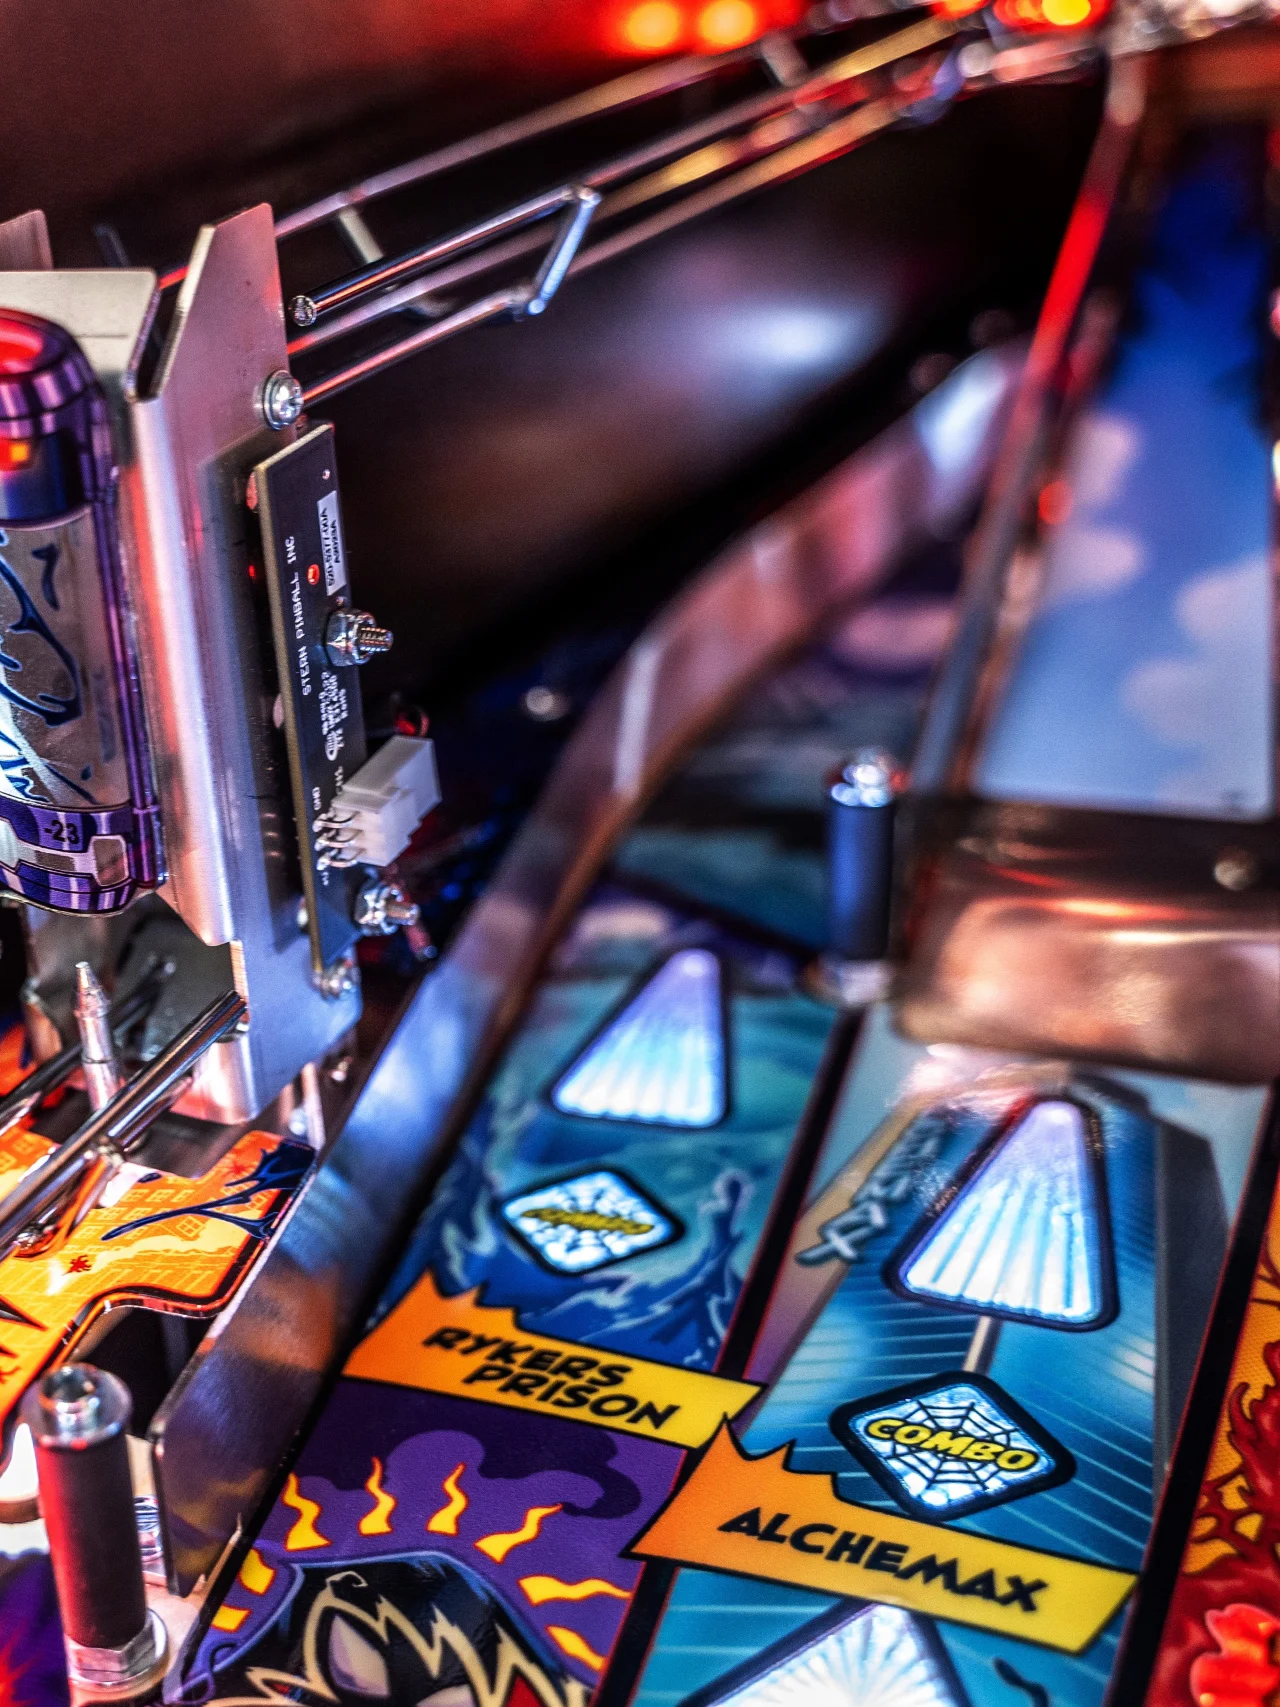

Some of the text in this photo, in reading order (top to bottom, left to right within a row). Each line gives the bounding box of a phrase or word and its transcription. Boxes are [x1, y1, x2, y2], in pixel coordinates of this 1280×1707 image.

[285, 536, 312, 696] STERN PINBALL INC
[44, 820, 79, 844] -23
[423, 1326, 632, 1387] RYKERS
[462, 1364, 681, 1429] PRISON
[866, 1419, 1038, 1470] COMBO
[717, 1507, 1048, 1612] ALCHEMAX
